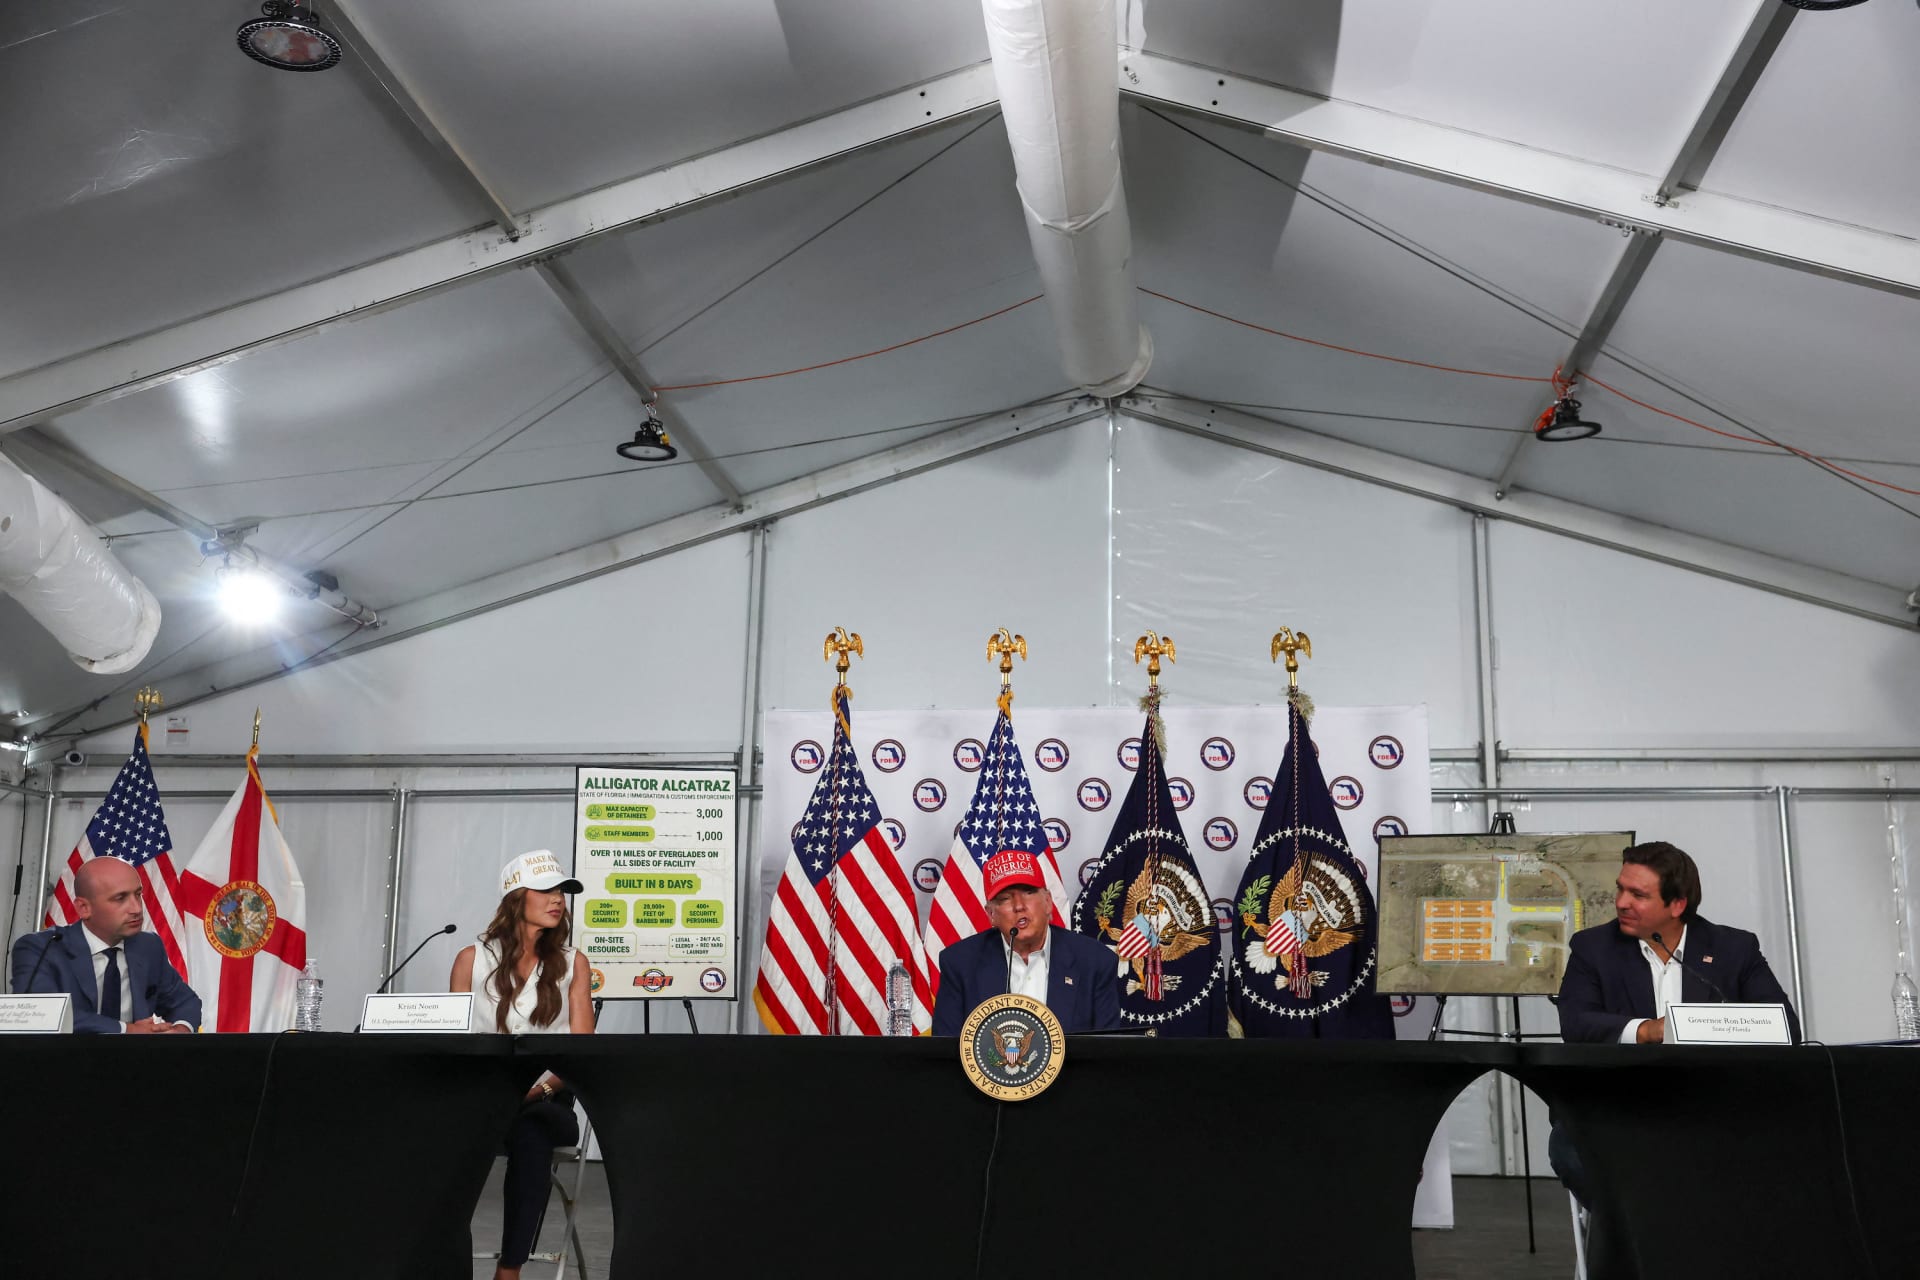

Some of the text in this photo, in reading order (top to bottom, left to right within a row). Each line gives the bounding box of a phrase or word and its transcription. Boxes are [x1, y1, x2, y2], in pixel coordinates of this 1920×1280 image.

[584, 777, 730, 792] ALLIGATOR ALCATRAZ
[696, 808, 723, 819] 3,000
[696, 831, 723, 842] 1,000
[623, 850, 646, 858] MILES
[647, 850, 657, 858] OF
[659, 850, 706, 858] EVERGLADES
[525, 855, 546, 866] MAKE
[663, 860, 696, 868] FACILITY
[987, 852, 1031, 870] GULF OF
[533, 865, 555, 876] GREAT
[990, 861, 1033, 880] AMERICA
[615, 879, 693, 889] BUILT IN 8 DAYS
[964, 997, 1062, 1096] SEAL OF THE PRESIDENT OF THE UNITED STATES
